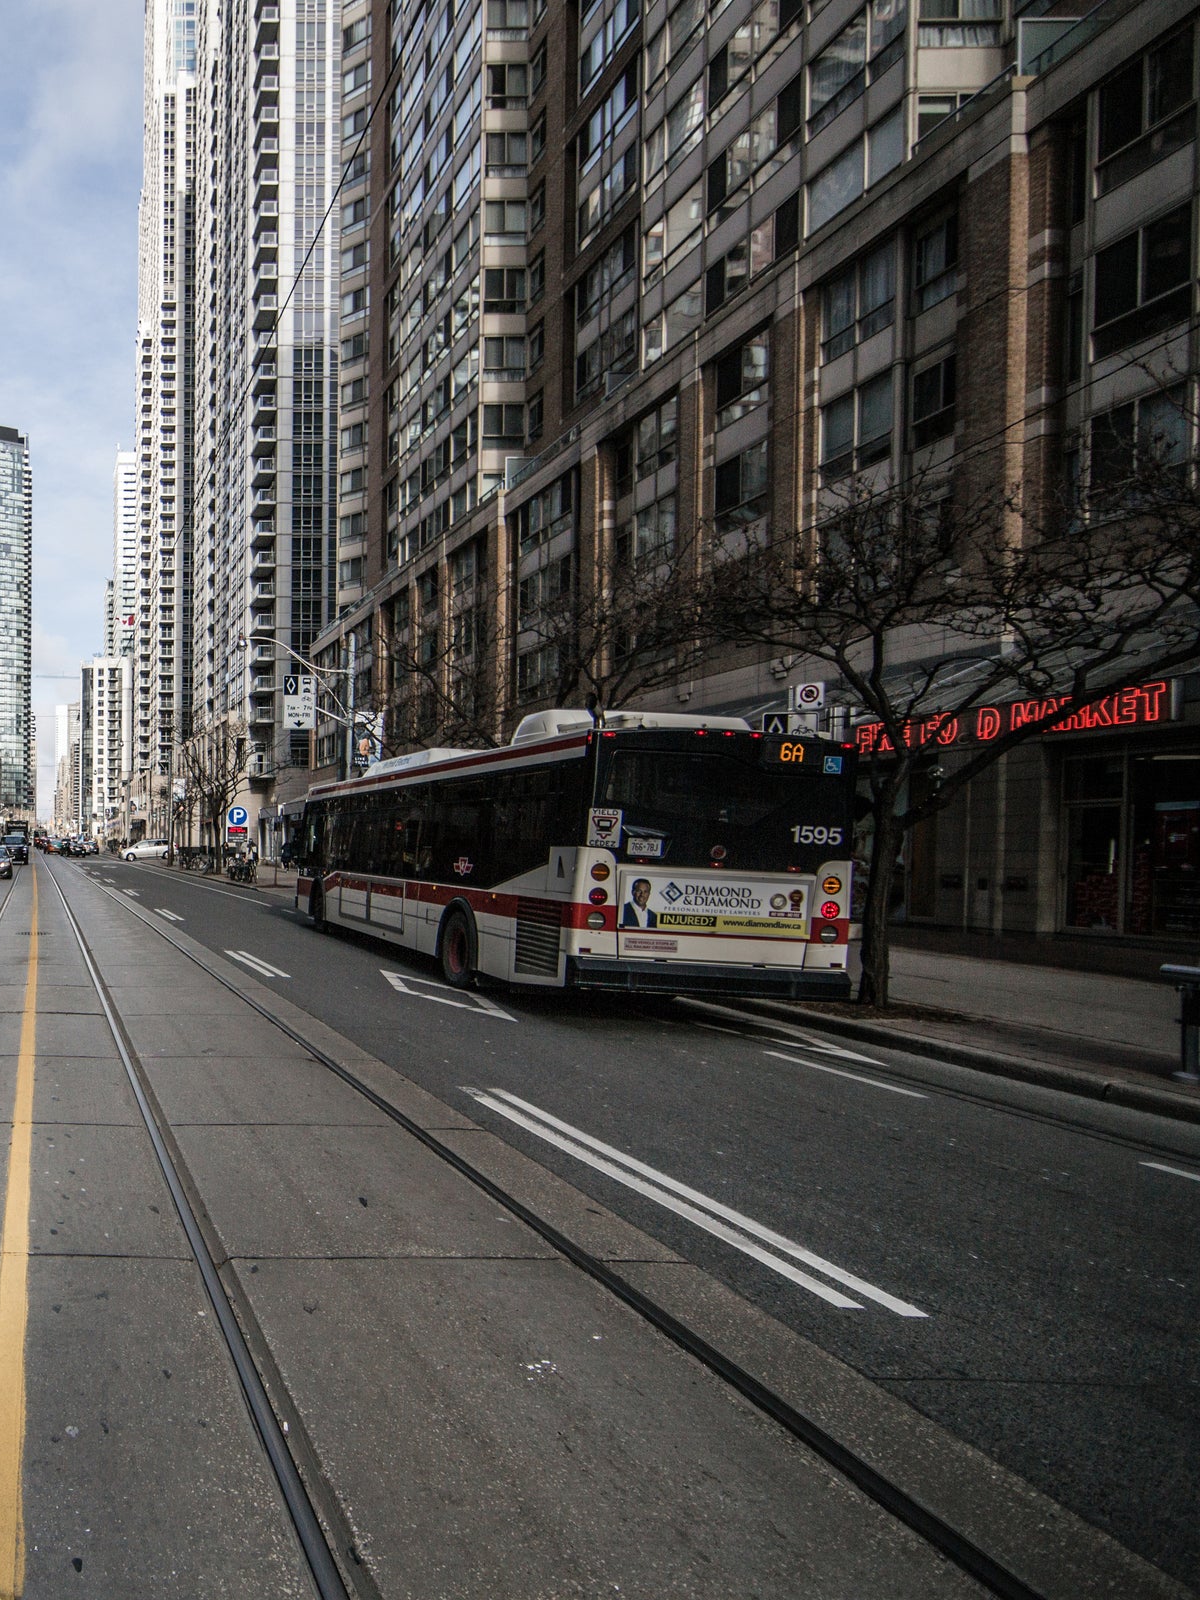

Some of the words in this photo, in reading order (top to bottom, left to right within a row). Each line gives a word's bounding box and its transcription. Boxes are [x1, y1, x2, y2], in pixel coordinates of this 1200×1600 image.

[921, 707, 1001, 745] FOD
[780, 742, 804, 762] 6A
[233, 809, 245, 823] P
[790, 825, 842, 845] 1595
[685, 885, 752, 898] DIAMOND
[694, 896, 761, 909] DIAMOND
[663, 914, 714, 926] INJURED?
[723, 919, 802, 930] www.diamondlaw.ca
